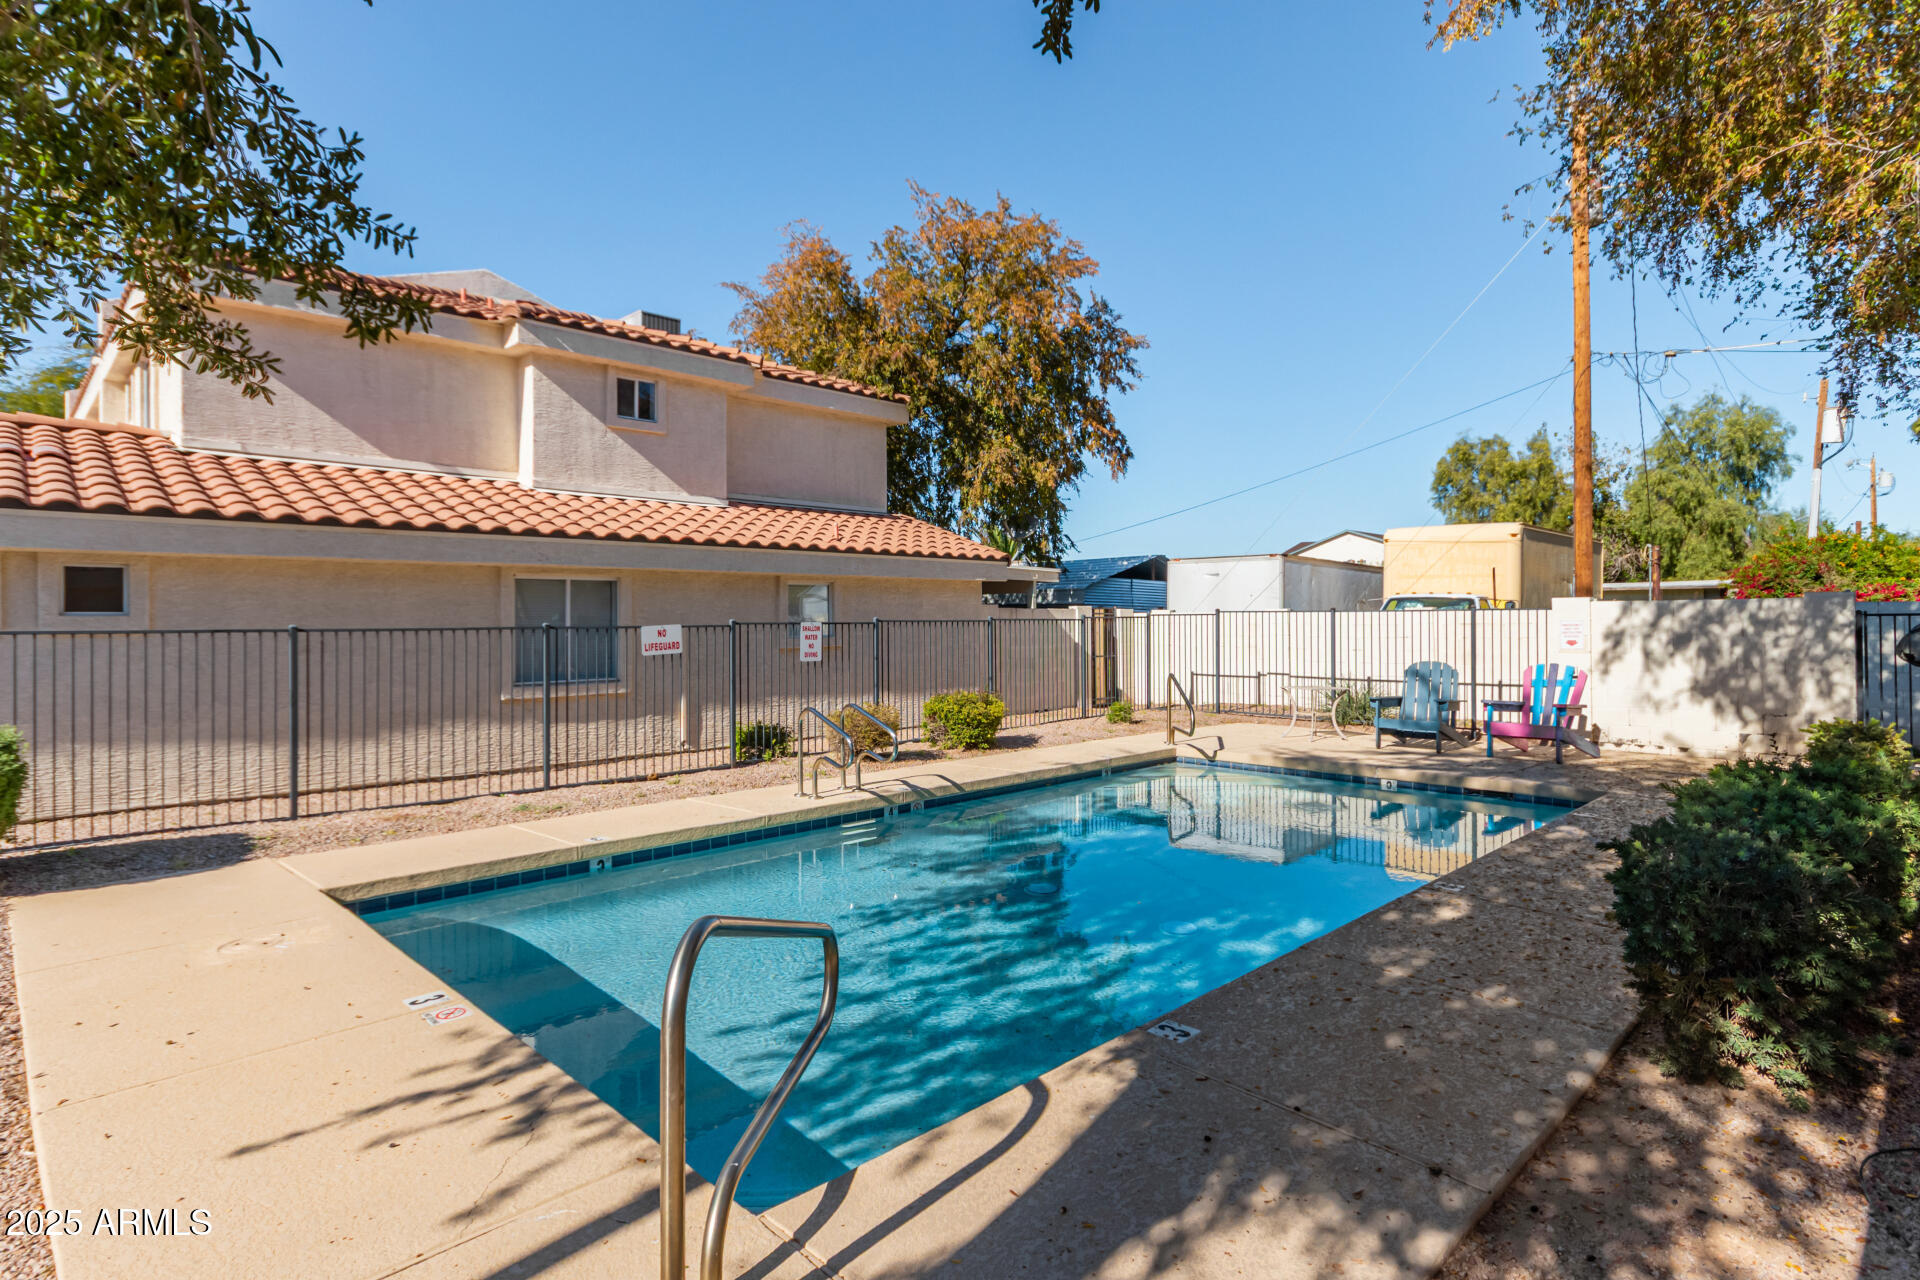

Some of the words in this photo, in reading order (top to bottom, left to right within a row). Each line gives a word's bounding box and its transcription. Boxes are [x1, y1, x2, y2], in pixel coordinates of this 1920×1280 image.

[657, 629, 667, 638] NO
[644, 641, 680, 652] LIFEGUARD
[1158, 1024, 1191, 1038] 3
